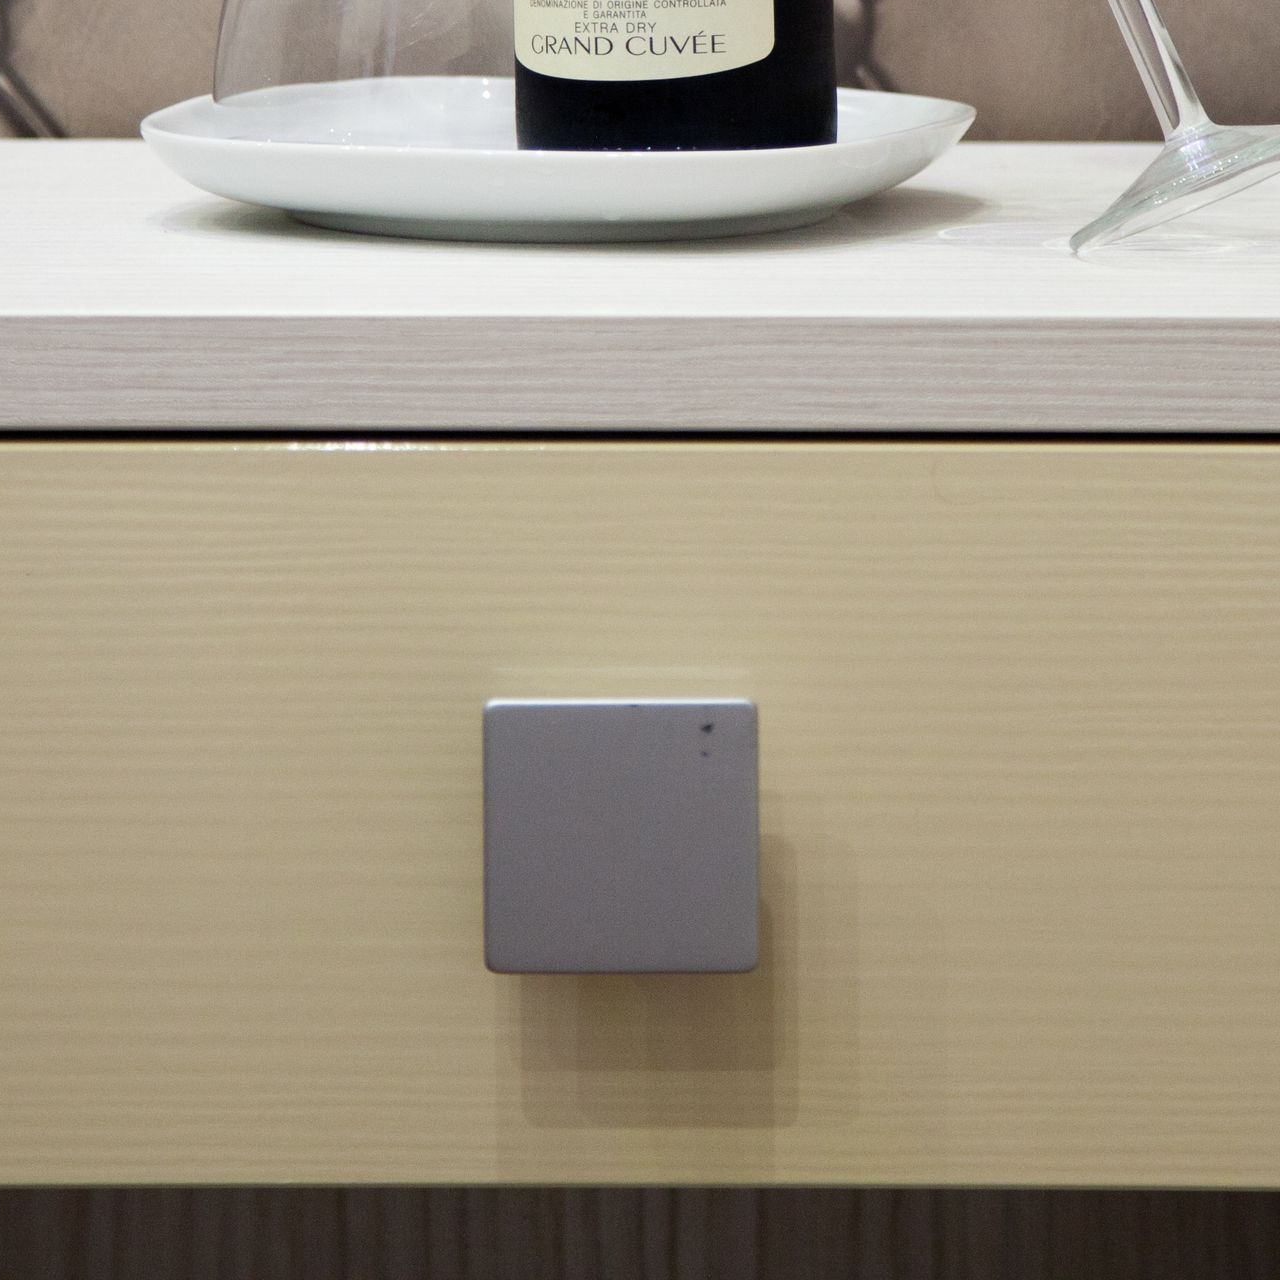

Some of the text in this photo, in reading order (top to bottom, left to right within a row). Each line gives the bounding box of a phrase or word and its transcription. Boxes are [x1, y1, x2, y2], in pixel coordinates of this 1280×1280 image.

[593, 1, 602, 9] DI
[607, 0, 648, 9] ORIGINE
[583, 10, 647, 19] E GARANTITA
[575, 22, 657, 33] EXTRA DRY
[531, 31, 727, 56] GRAND CUVÉE
